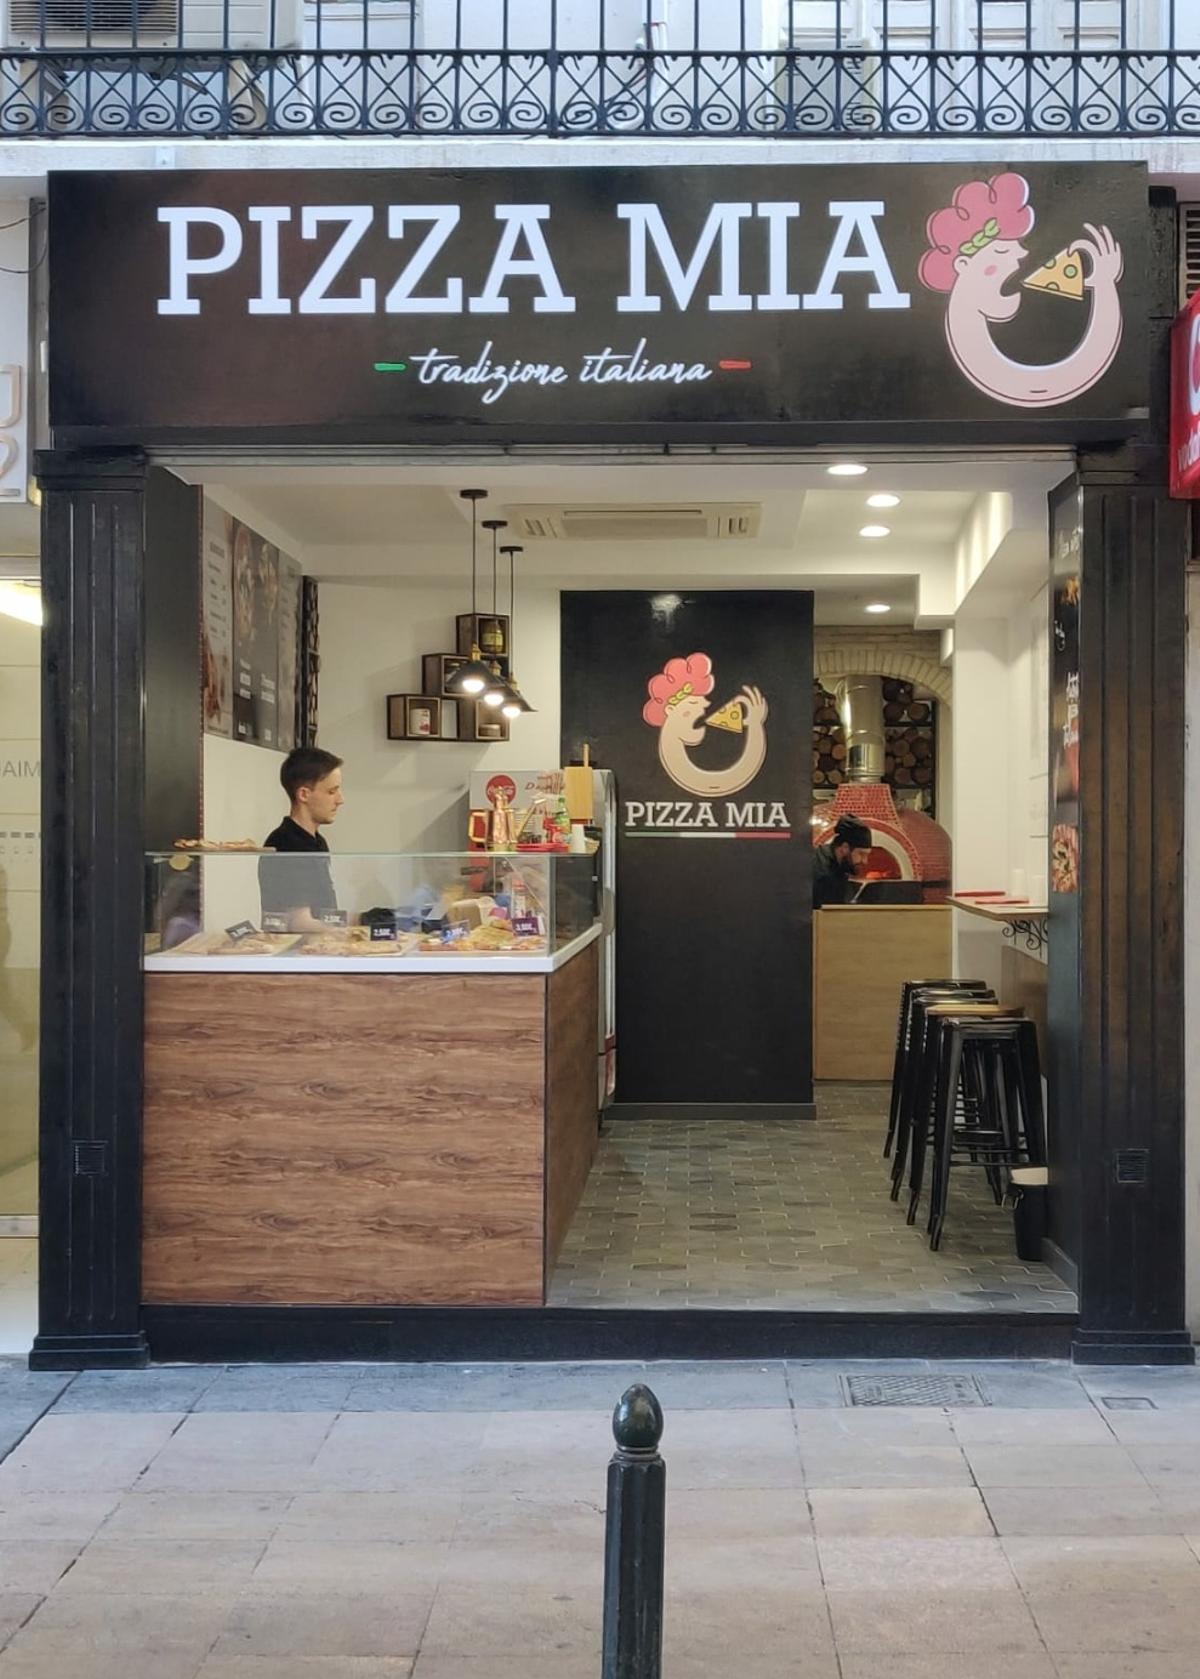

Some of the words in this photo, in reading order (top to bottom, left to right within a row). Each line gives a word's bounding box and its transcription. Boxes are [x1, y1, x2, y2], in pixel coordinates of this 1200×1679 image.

[157, 203, 576, 316] PIZZA
[617, 200, 911, 312] MIA
[409, 340, 569, 405] tradizione
[579, 337, 713, 385] italiana
[625, 801, 719, 828] PIZZA
[725, 801, 792, 828] MIA
